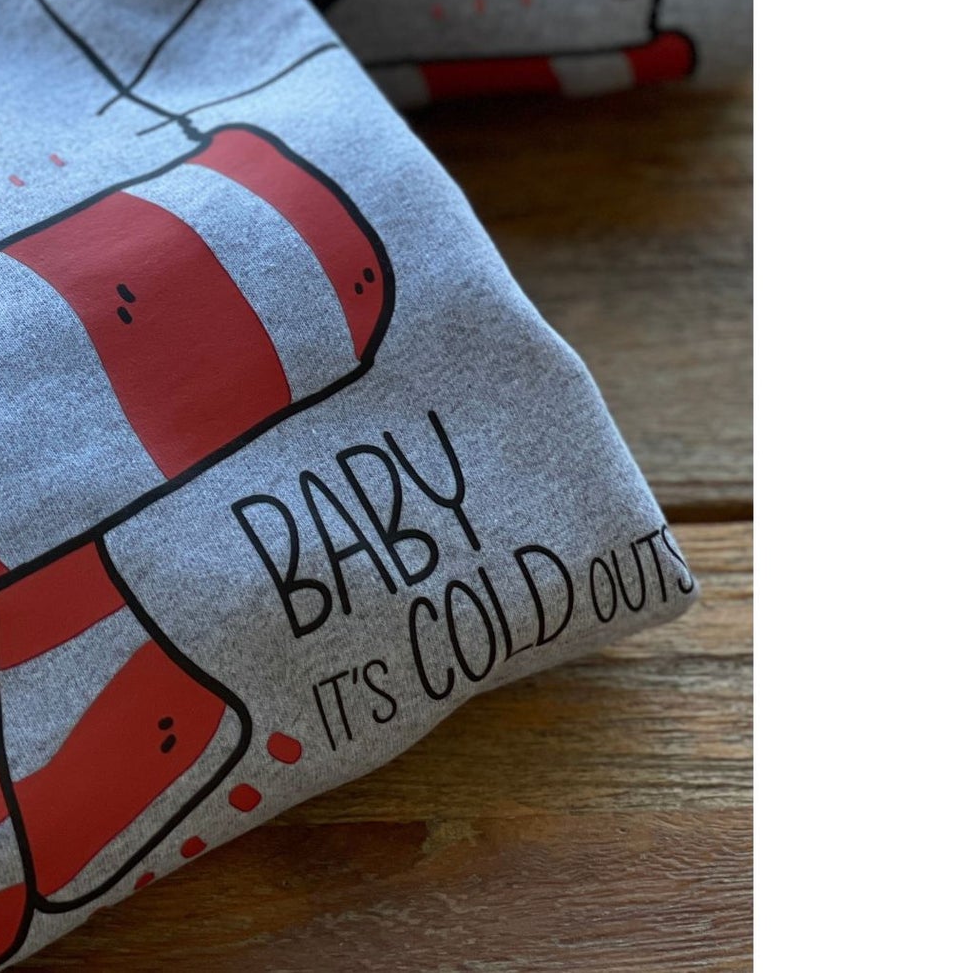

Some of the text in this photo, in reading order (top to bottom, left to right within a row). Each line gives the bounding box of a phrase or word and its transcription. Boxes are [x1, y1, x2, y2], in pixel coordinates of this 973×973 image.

[231, 410, 481, 639] BABY
[312, 659, 398, 751] IT'S
[409, 545, 574, 701] COLD
